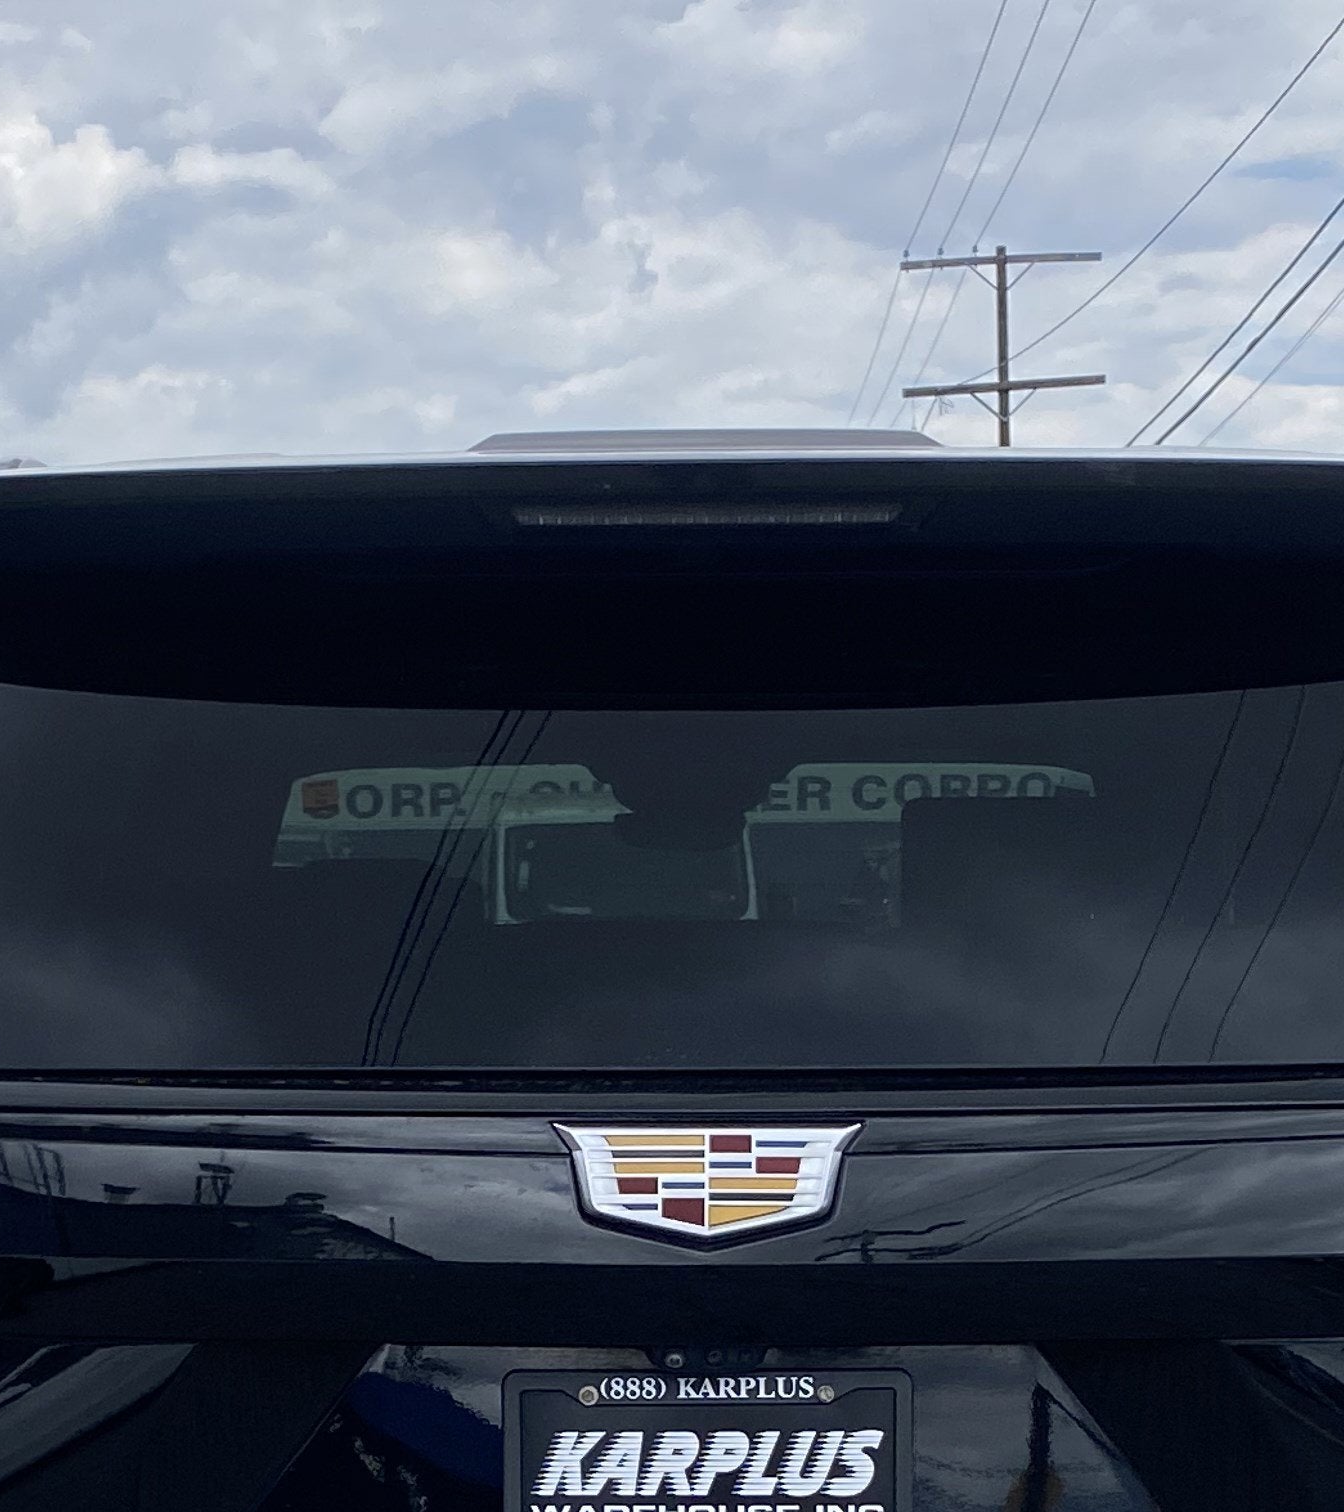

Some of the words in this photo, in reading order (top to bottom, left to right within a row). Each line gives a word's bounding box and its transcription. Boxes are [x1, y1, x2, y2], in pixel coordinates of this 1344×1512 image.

[302, 780, 467, 819] ORP.
[599, 1376, 667, 1400] (888)
[676, 1376, 815, 1400] KARPLUS
[530, 1428, 885, 1498] KARPLUS
